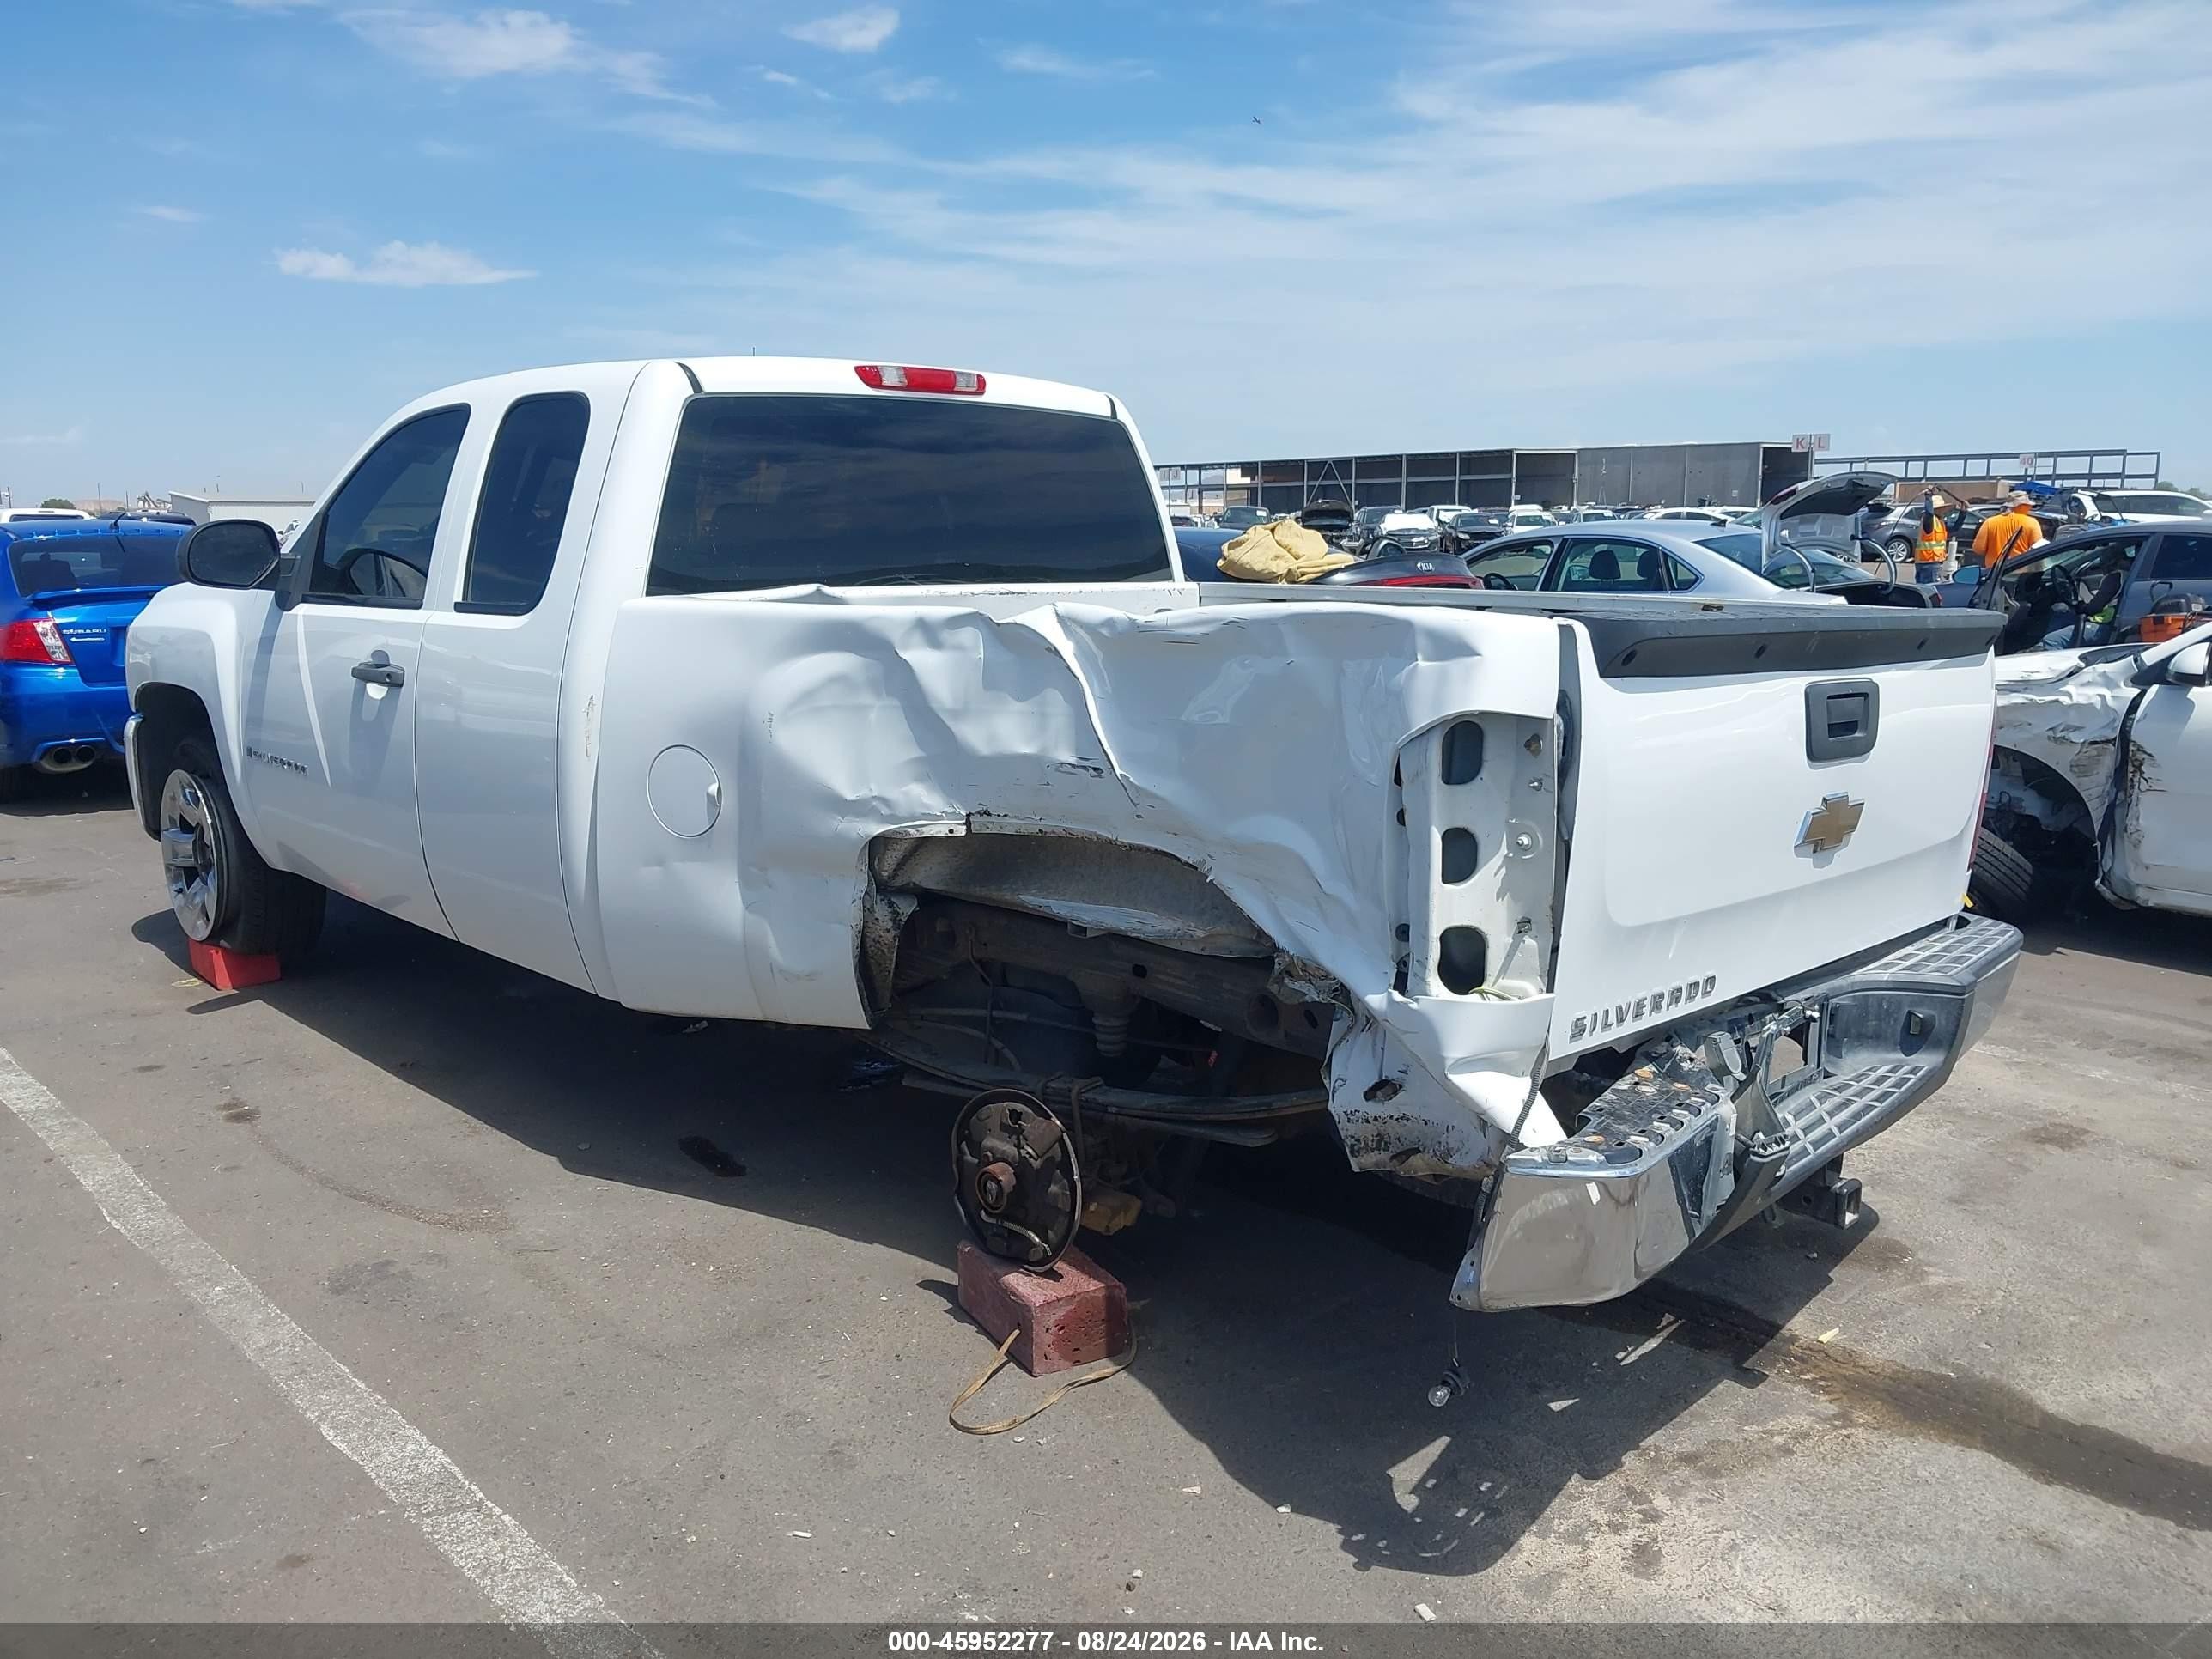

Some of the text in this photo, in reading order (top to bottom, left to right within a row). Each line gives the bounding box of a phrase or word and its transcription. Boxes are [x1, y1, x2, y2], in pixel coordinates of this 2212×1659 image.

[1796, 437, 1805, 449] K
[1818, 436, 1826, 448] L
[2019, 457, 2034, 465] 40
[1421, 562, 1435, 571] KIA
[1570, 975, 1717, 1042] SILVERADO
